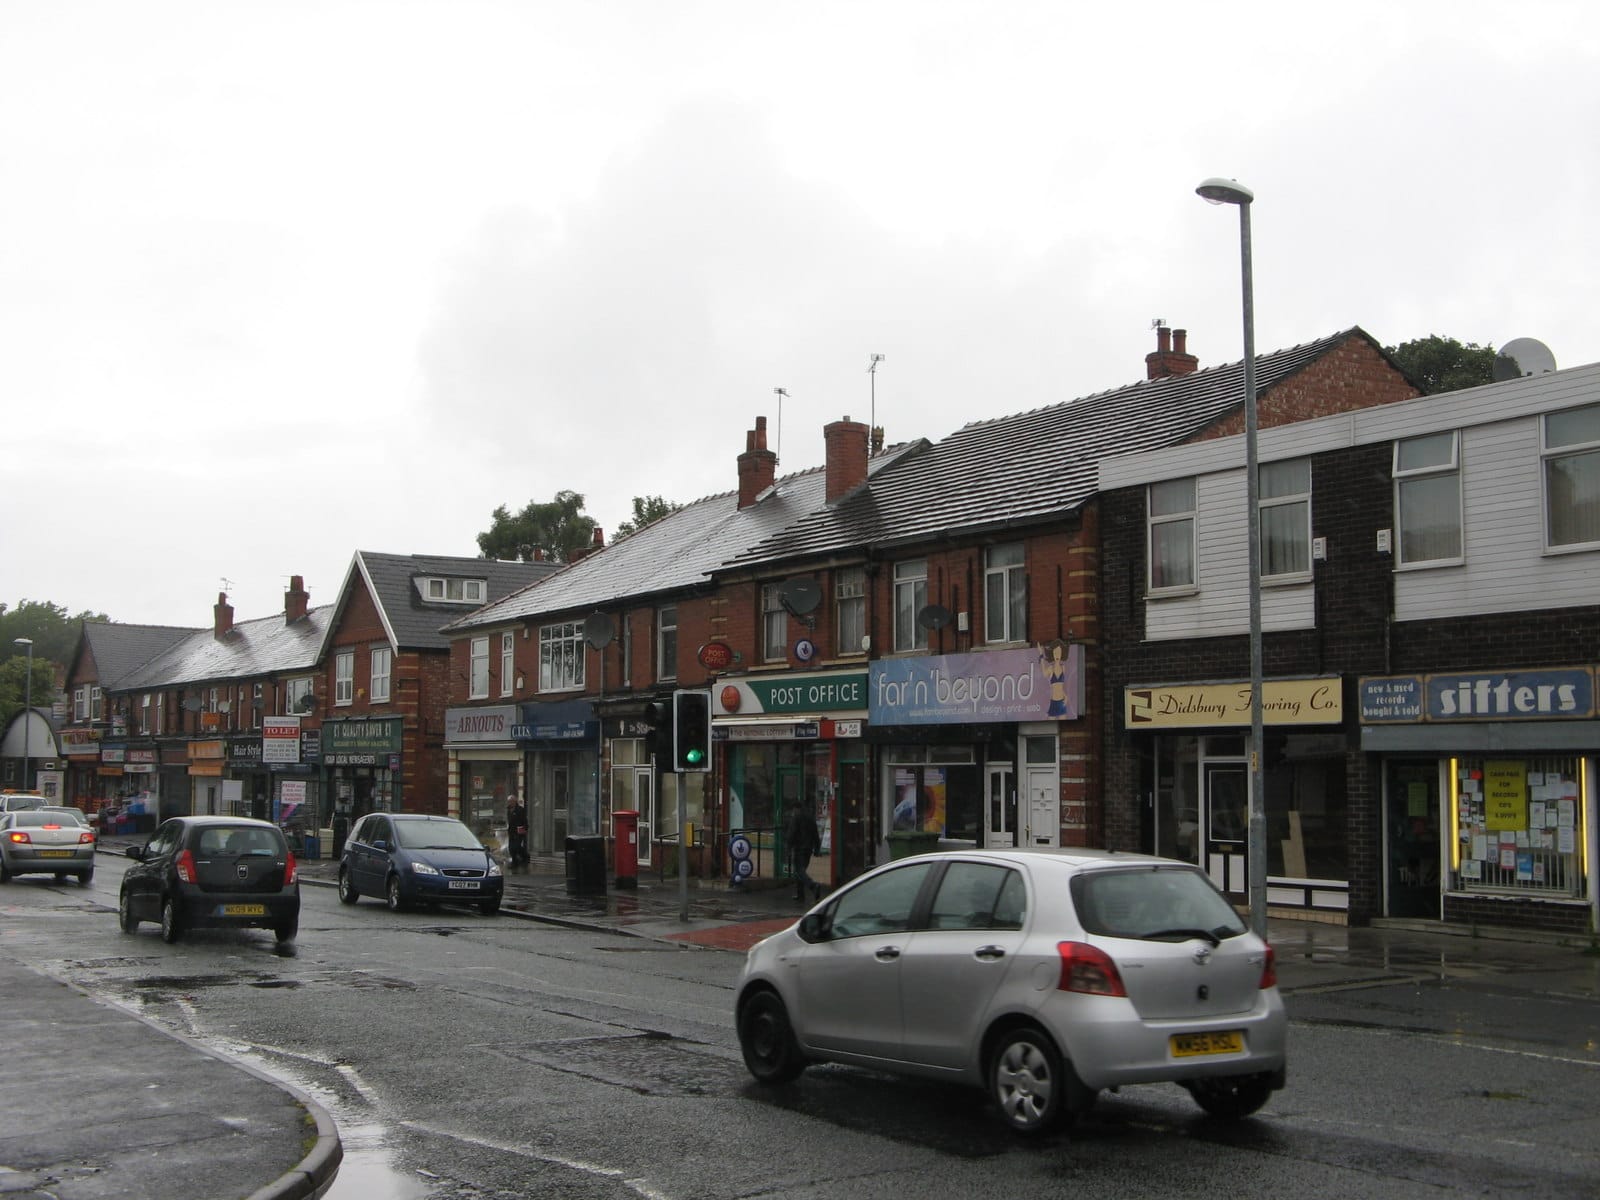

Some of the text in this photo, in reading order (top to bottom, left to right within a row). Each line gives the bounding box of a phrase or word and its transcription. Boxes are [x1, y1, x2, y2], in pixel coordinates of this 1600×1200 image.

[771, 683, 859, 705] POST OFFICE
[1367, 683, 1384, 693] new
[1393, 682, 1414, 692] used
[1157, 693, 1226, 718] Didsbury
[1310, 686, 1338, 710] Co.
[1376, 694, 1405, 704] records
[1440, 679, 1576, 715] sifters
[981, 705, 1003, 716] design
[1006, 704, 1022, 714] print
[1026, 703, 1041, 712] web
[1363, 707, 1392, 717] bought
[1401, 705, 1420, 715] sold
[342, 722, 365, 737] QUALITY
[365, 722, 382, 737] SAVER
[456, 714, 505, 733] ARNOUTS
[234, 744, 246, 756] Hair
[336, 755, 348, 764] LOCAL
[349, 755, 375, 764] NEWSAGENTS
